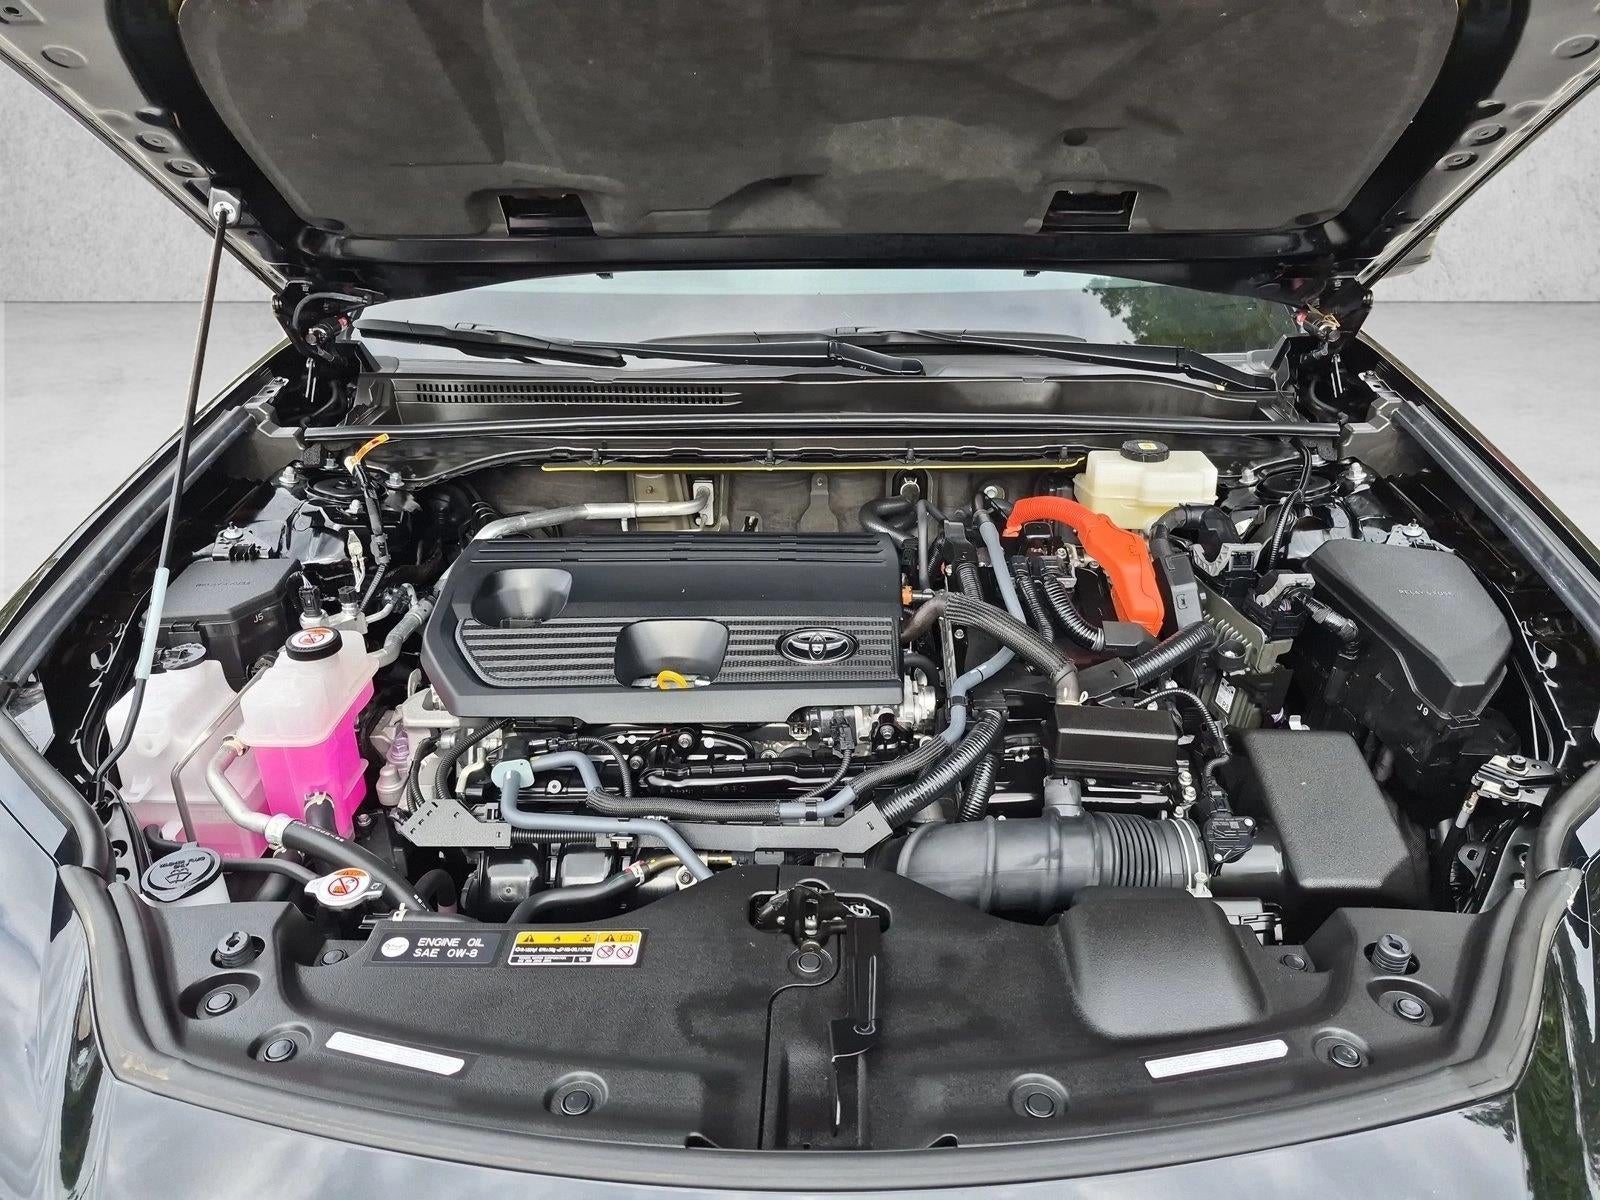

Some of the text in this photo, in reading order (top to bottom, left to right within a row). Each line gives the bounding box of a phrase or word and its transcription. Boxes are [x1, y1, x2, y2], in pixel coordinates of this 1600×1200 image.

[253, 612, 264, 623] J5
[1416, 703, 1429, 716] J9
[417, 937, 461, 947] ENGINE
[466, 938, 485, 948] OIL
[413, 948, 440, 958] SAE
